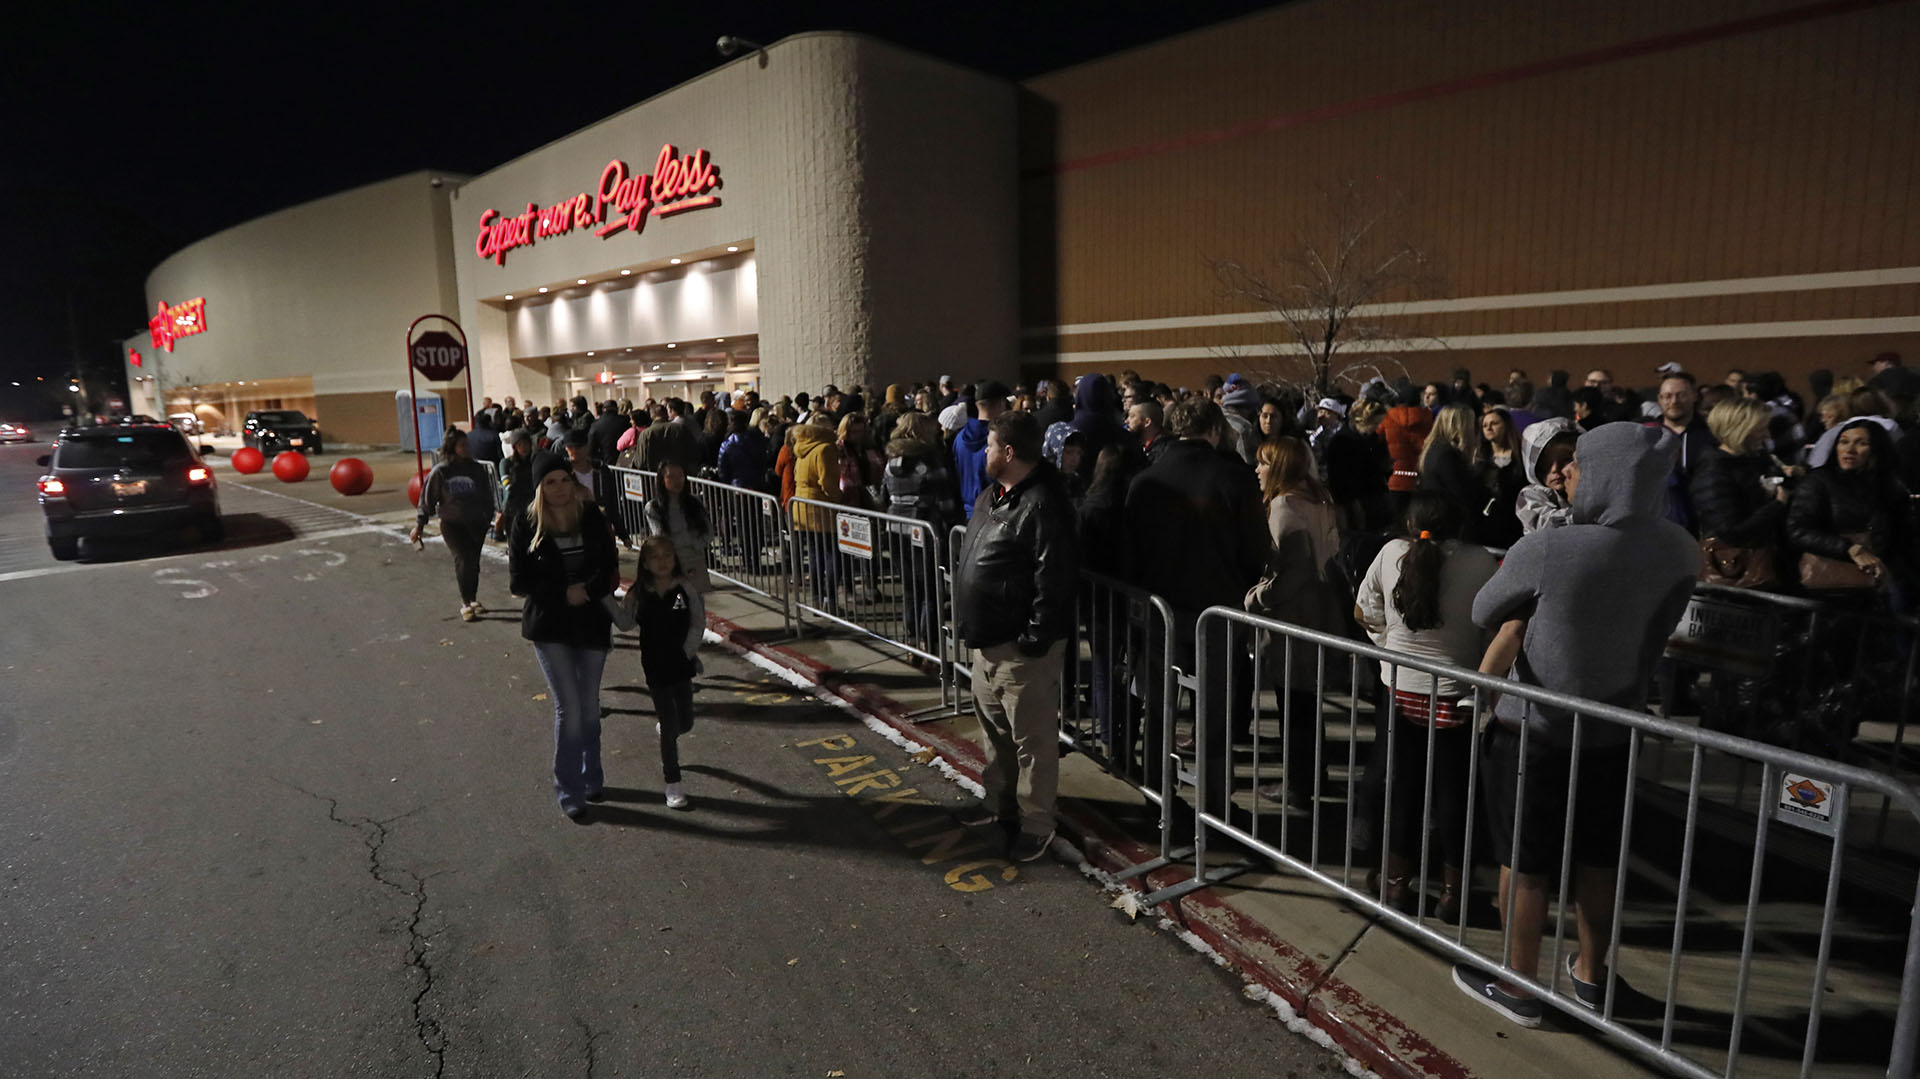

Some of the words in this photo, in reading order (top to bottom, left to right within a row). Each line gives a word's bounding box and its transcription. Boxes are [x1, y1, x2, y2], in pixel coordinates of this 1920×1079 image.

[476, 202, 536, 265] Expect
[536, 192, 592, 238] more.
[595, 159, 648, 231] Pay
[650, 143, 717, 201] less.
[416, 346, 460, 366] STOP
[796, 733, 1019, 892] PARKING
